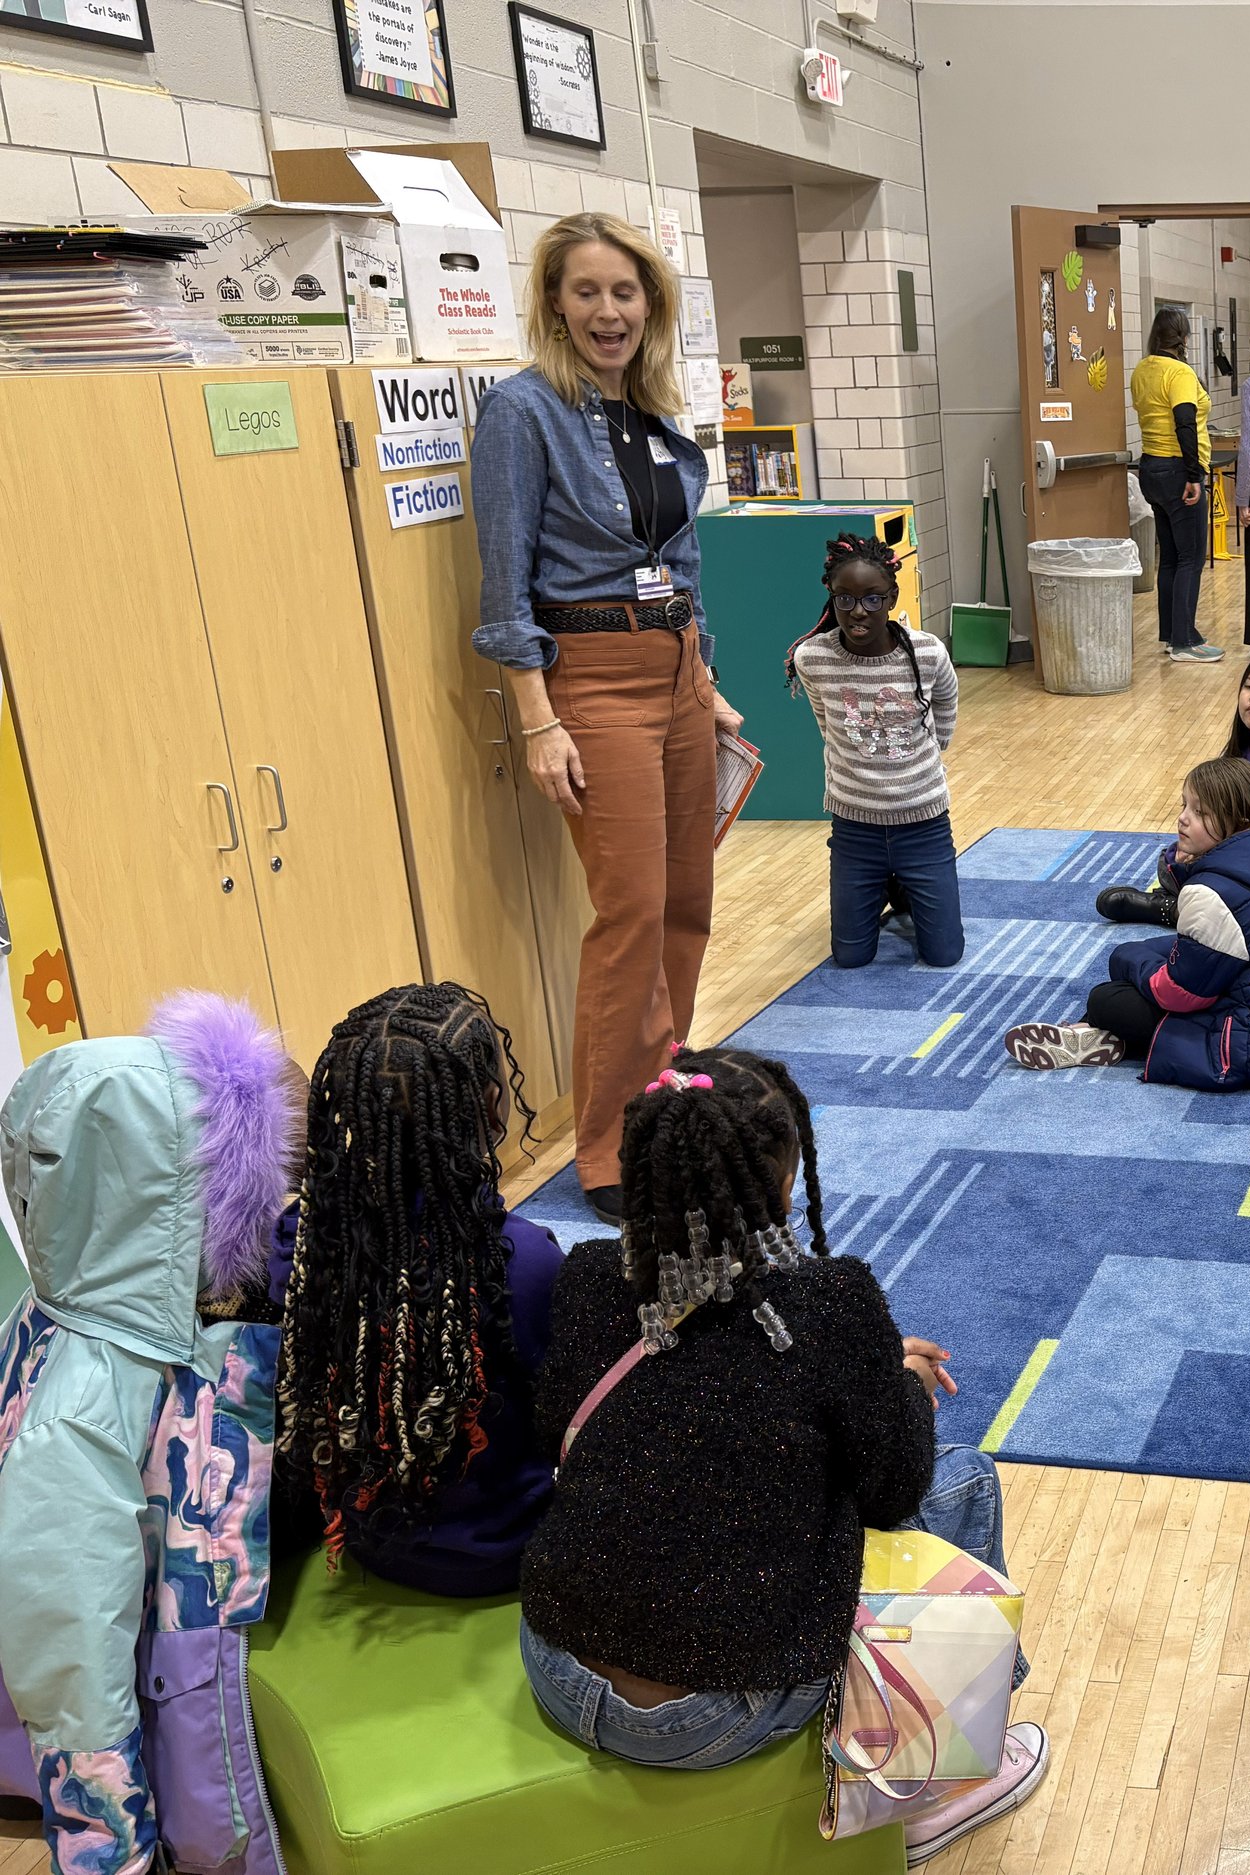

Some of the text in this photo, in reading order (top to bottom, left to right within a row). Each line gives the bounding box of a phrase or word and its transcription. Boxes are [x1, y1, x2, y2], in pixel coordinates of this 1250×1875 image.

[84, 3, 131, 22] -Carl Sagan
[400, 4, 412, 15] are
[368, 11, 414, 34] the portals of
[550, 43, 559, 53] the
[376, 51, 418, 71] -James Joyce
[558, 76, 580, 91] -Socrates
[819, 53, 839, 102] EXIT
[220, 289, 242, 299] USA
[439, 287, 490, 302] The Whole
[438, 303, 497, 318] Class Reads!
[221, 315, 299, 325] TI-USE COPY PAPER
[762, 344, 781, 354] 1051
[378, 377, 458, 423] Word
[730, 386, 749, 399] Socks
[225, 408, 280, 435] Legos
[382, 437, 461, 467] Nonfiction
[392, 480, 461, 518] Fiction
